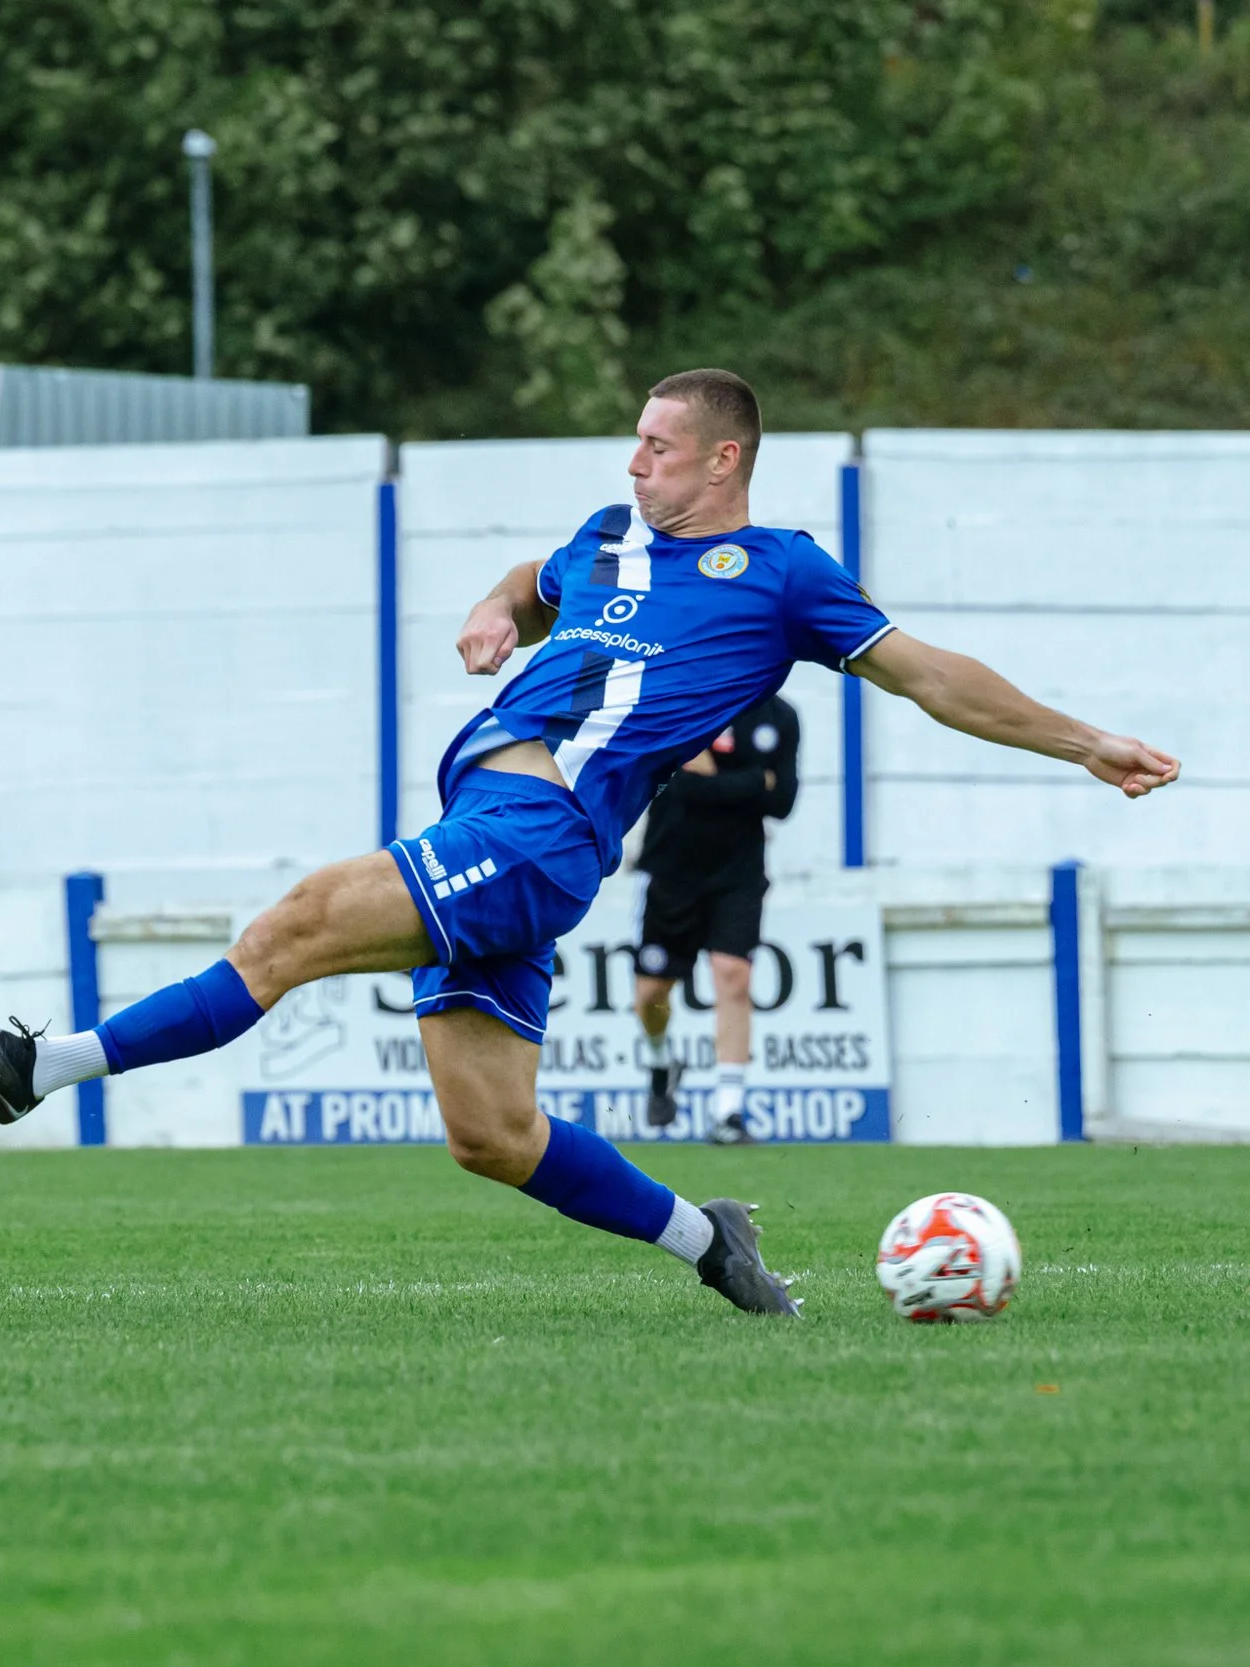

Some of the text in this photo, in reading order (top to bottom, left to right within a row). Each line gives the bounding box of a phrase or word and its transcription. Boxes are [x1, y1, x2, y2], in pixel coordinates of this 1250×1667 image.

[554, 627, 665, 657] accessplanit
[763, 1034, 871, 1071] BASSES
[259, 1092, 310, 1141] AT
[745, 1090, 866, 1140] SHOP
